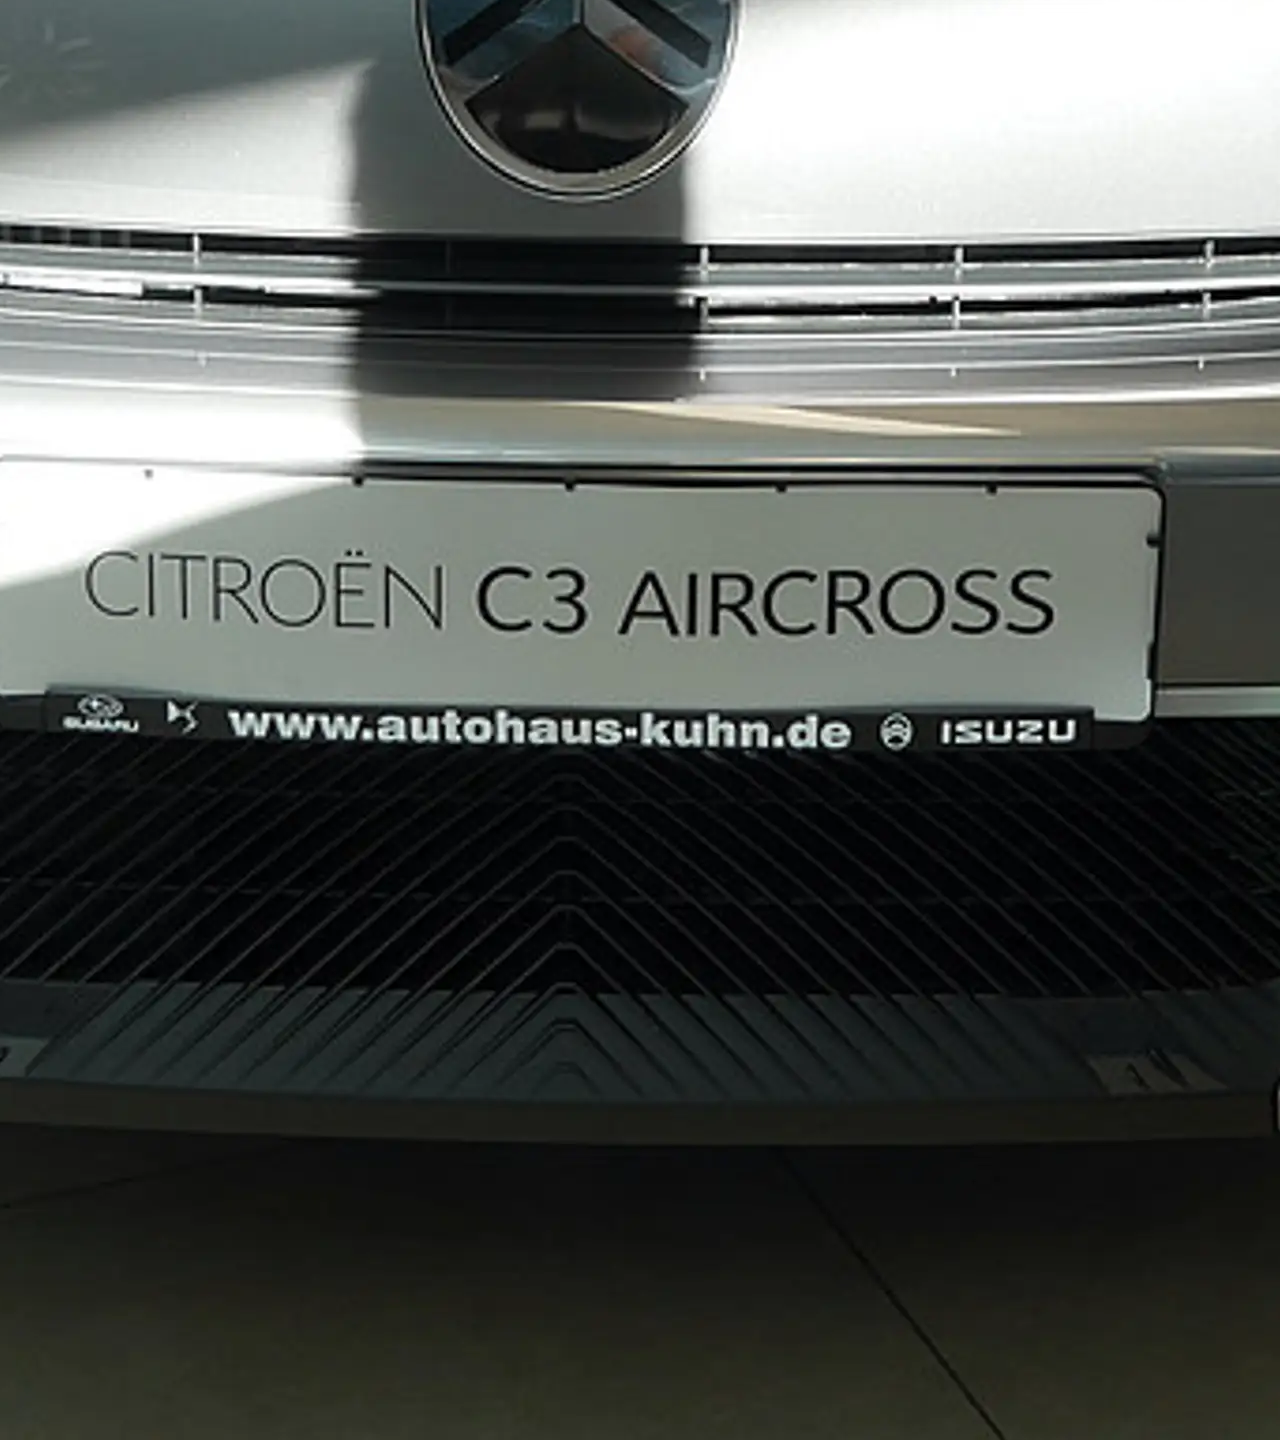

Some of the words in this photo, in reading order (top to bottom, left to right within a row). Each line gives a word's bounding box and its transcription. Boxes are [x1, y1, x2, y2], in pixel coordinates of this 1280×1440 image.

[85, 549, 446, 632] CITROËN
[477, 565, 588, 635] C3
[617, 568, 1056, 638] AIRCROSS
[62, 714, 139, 733] SUBARU
[227, 708, 852, 749] www.autohaus-kuhn.de
[940, 718, 1077, 745] ISUZU
